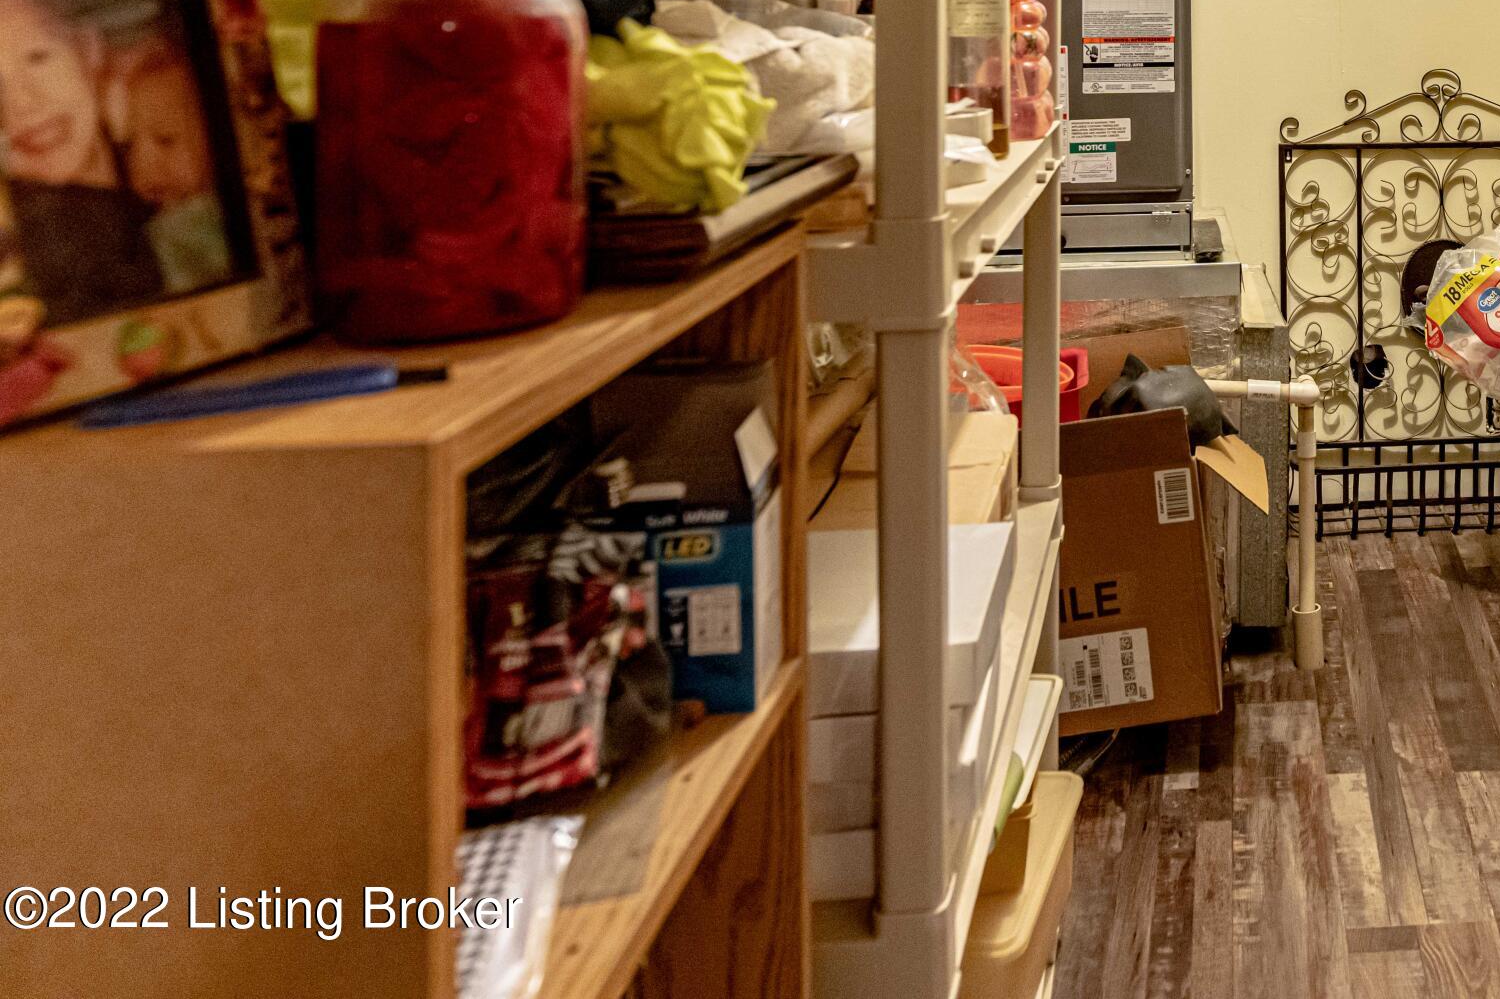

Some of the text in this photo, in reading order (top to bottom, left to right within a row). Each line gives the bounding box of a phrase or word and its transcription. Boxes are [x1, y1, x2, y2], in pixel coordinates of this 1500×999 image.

[1078, 143, 1107, 151] NOTICE
[1443, 263, 1490, 306] 18 MEGA
[664, 534, 711, 558] LED
[1059, 580, 1121, 625] ILE
